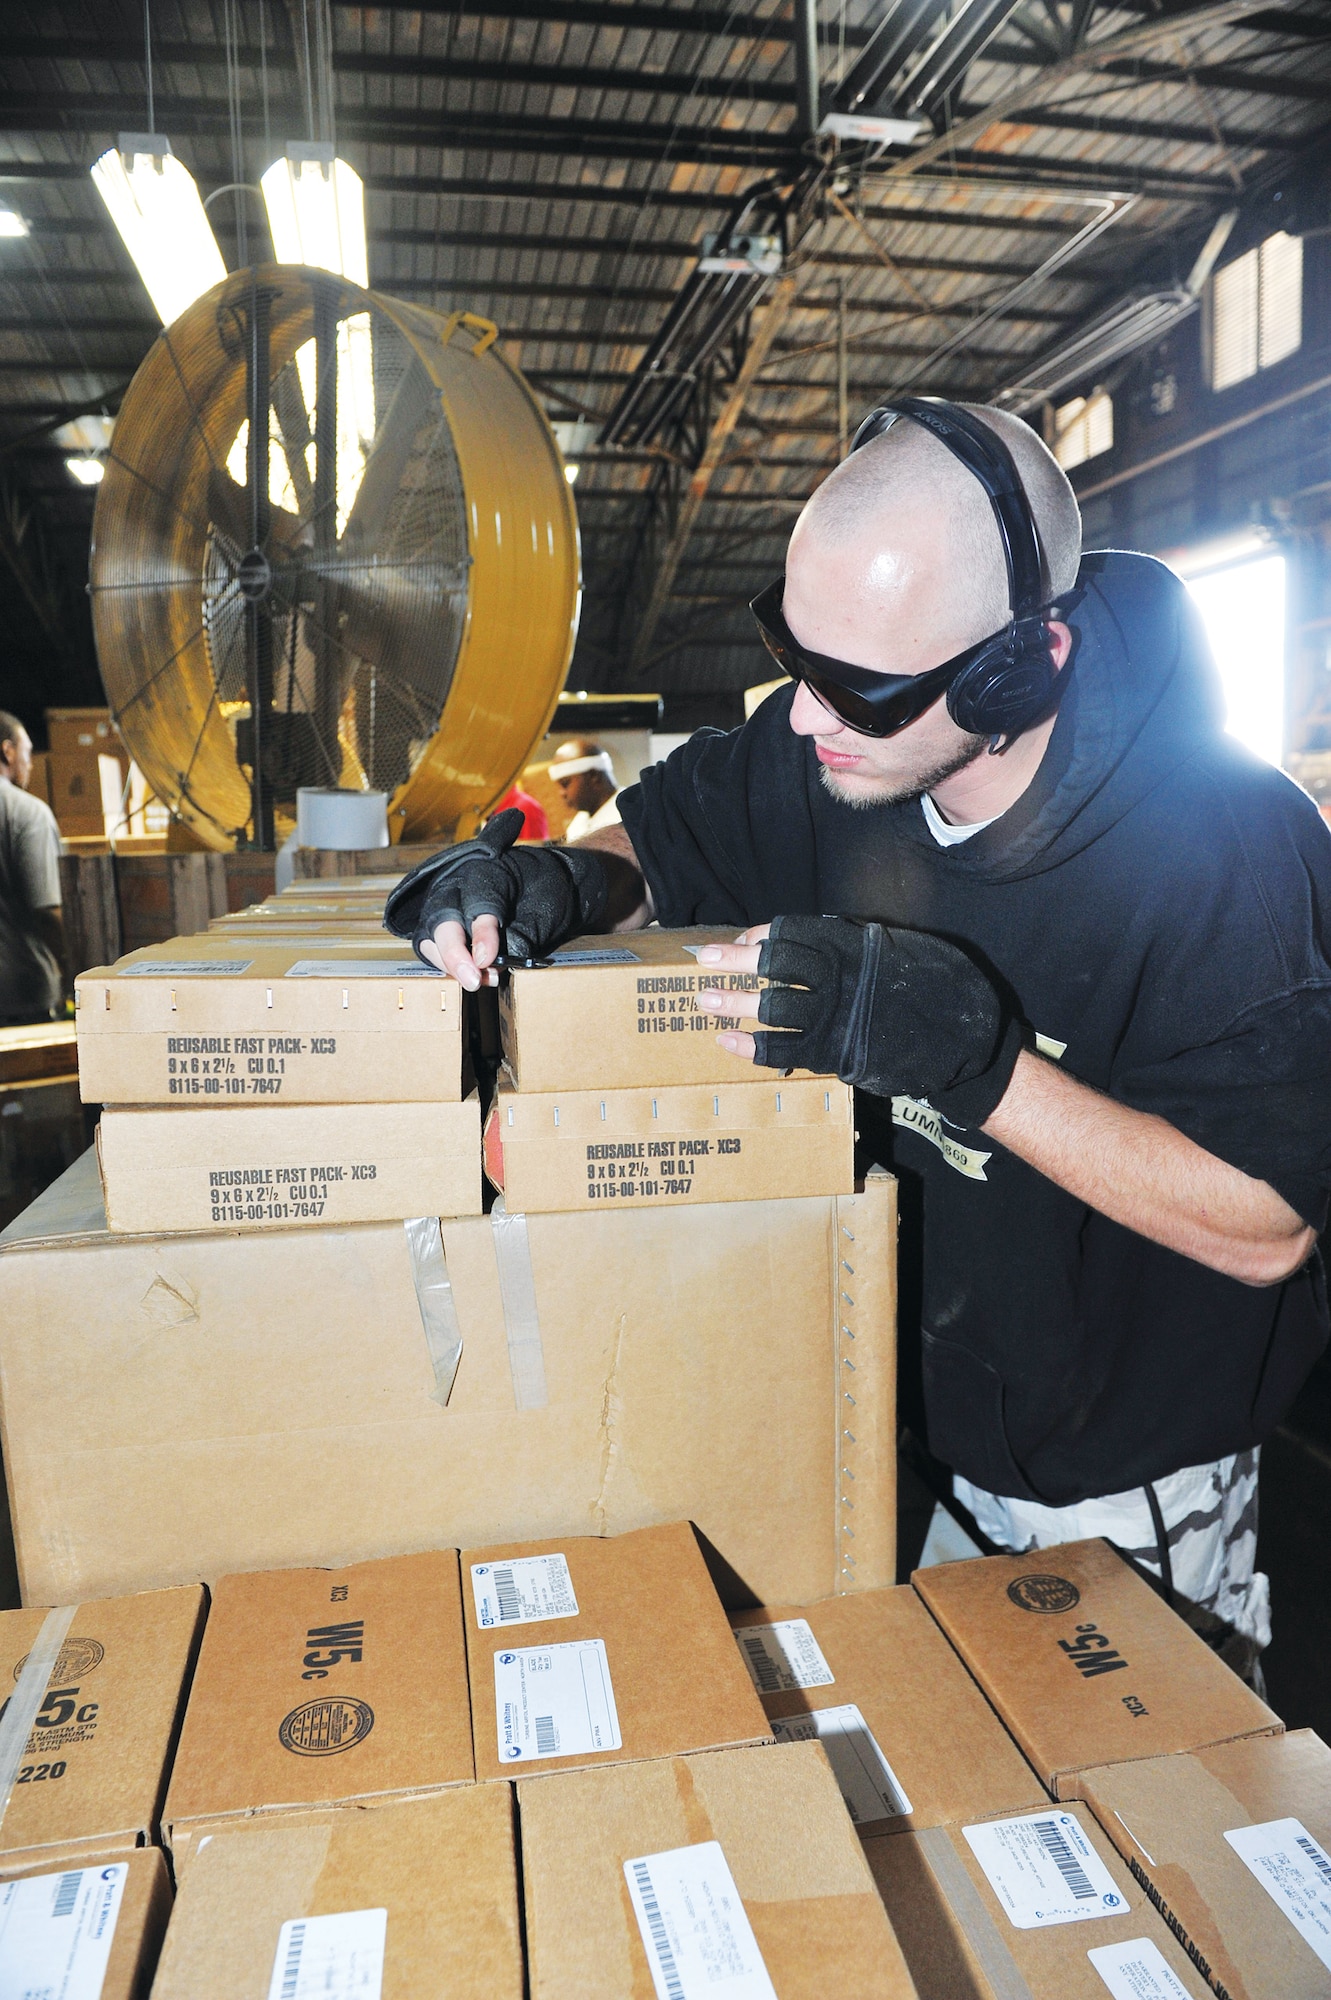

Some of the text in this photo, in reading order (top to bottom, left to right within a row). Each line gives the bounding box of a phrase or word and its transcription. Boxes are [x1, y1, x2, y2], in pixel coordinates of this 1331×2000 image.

[913, 411, 954, 435] SONY
[636, 976, 696, 993] REUSABLE
[697, 975, 728, 991] FAST
[727, 974, 766, 992] PACK-
[637, 998, 646, 1014] 9
[648, 1000, 656, 1013] x
[657, 998, 666, 1013] 6
[668, 999, 676, 1013] x
[637, 1015, 742, 1034] 8115-00-101-7647
[167, 1037, 337, 1055] REUSABLE FAST PACK- XC3
[168, 1057, 177, 1074] 9
[179, 1060, 188, 1074] x
[190, 1057, 200, 1074] 6
[202, 1060, 211, 1074] x
[247, 1057, 264, 1074] CU
[266, 1057, 285, 1074] 0.1
[168, 1077, 282, 1094] 8115-00-101-7647
[586, 1138, 741, 1161] REUSABLE FAST PACK- XC3
[208, 1164, 377, 1187] REUSABLE FAST PACK- XC3
[587, 1163, 596, 1180] 9
[597, 1166, 606, 1179] x
[607, 1162, 616, 1178] 6
[618, 1165, 626, 1178] x
[660, 1160, 676, 1176] CU
[677, 1159, 695, 1175] 0.1
[210, 1188, 220, 1205] 9
[222, 1191, 231, 1204] x
[233, 1187, 243, 1203] 6
[245, 1190, 254, 1203] x
[289, 1185, 307, 1201] CU
[309, 1184, 328, 1200] 0.1
[588, 1178, 692, 1199] 8115-00-101-7647
[211, 1201, 325, 1222] 8115-00-101-7647
[330, 1584, 349, 1603] XC3
[301, 1620, 364, 1680] W5c
[1057, 1623, 1129, 1678] W5c
[503, 1702, 512, 1724] Whitney
[1121, 1695, 1150, 1718] XC3
[37, 1731, 86, 1743] MINIMUM
[46, 1726, 75, 1736] ASTM
[77, 1723, 98, 1731] STD
[504, 1730, 513, 1744] Pratt
[38, 1734, 94, 1748] STRENGTH
[104, 1884, 116, 1901] Pratt
[92, 1909, 110, 1940] Whitney
[1124, 1963, 1146, 1992] OPERATION
[1130, 1961, 1150, 1987] DELIVERY
[1137, 1960, 1162, 1993] WARRANTED
[1161, 1969, 1180, 1990] PRATT
